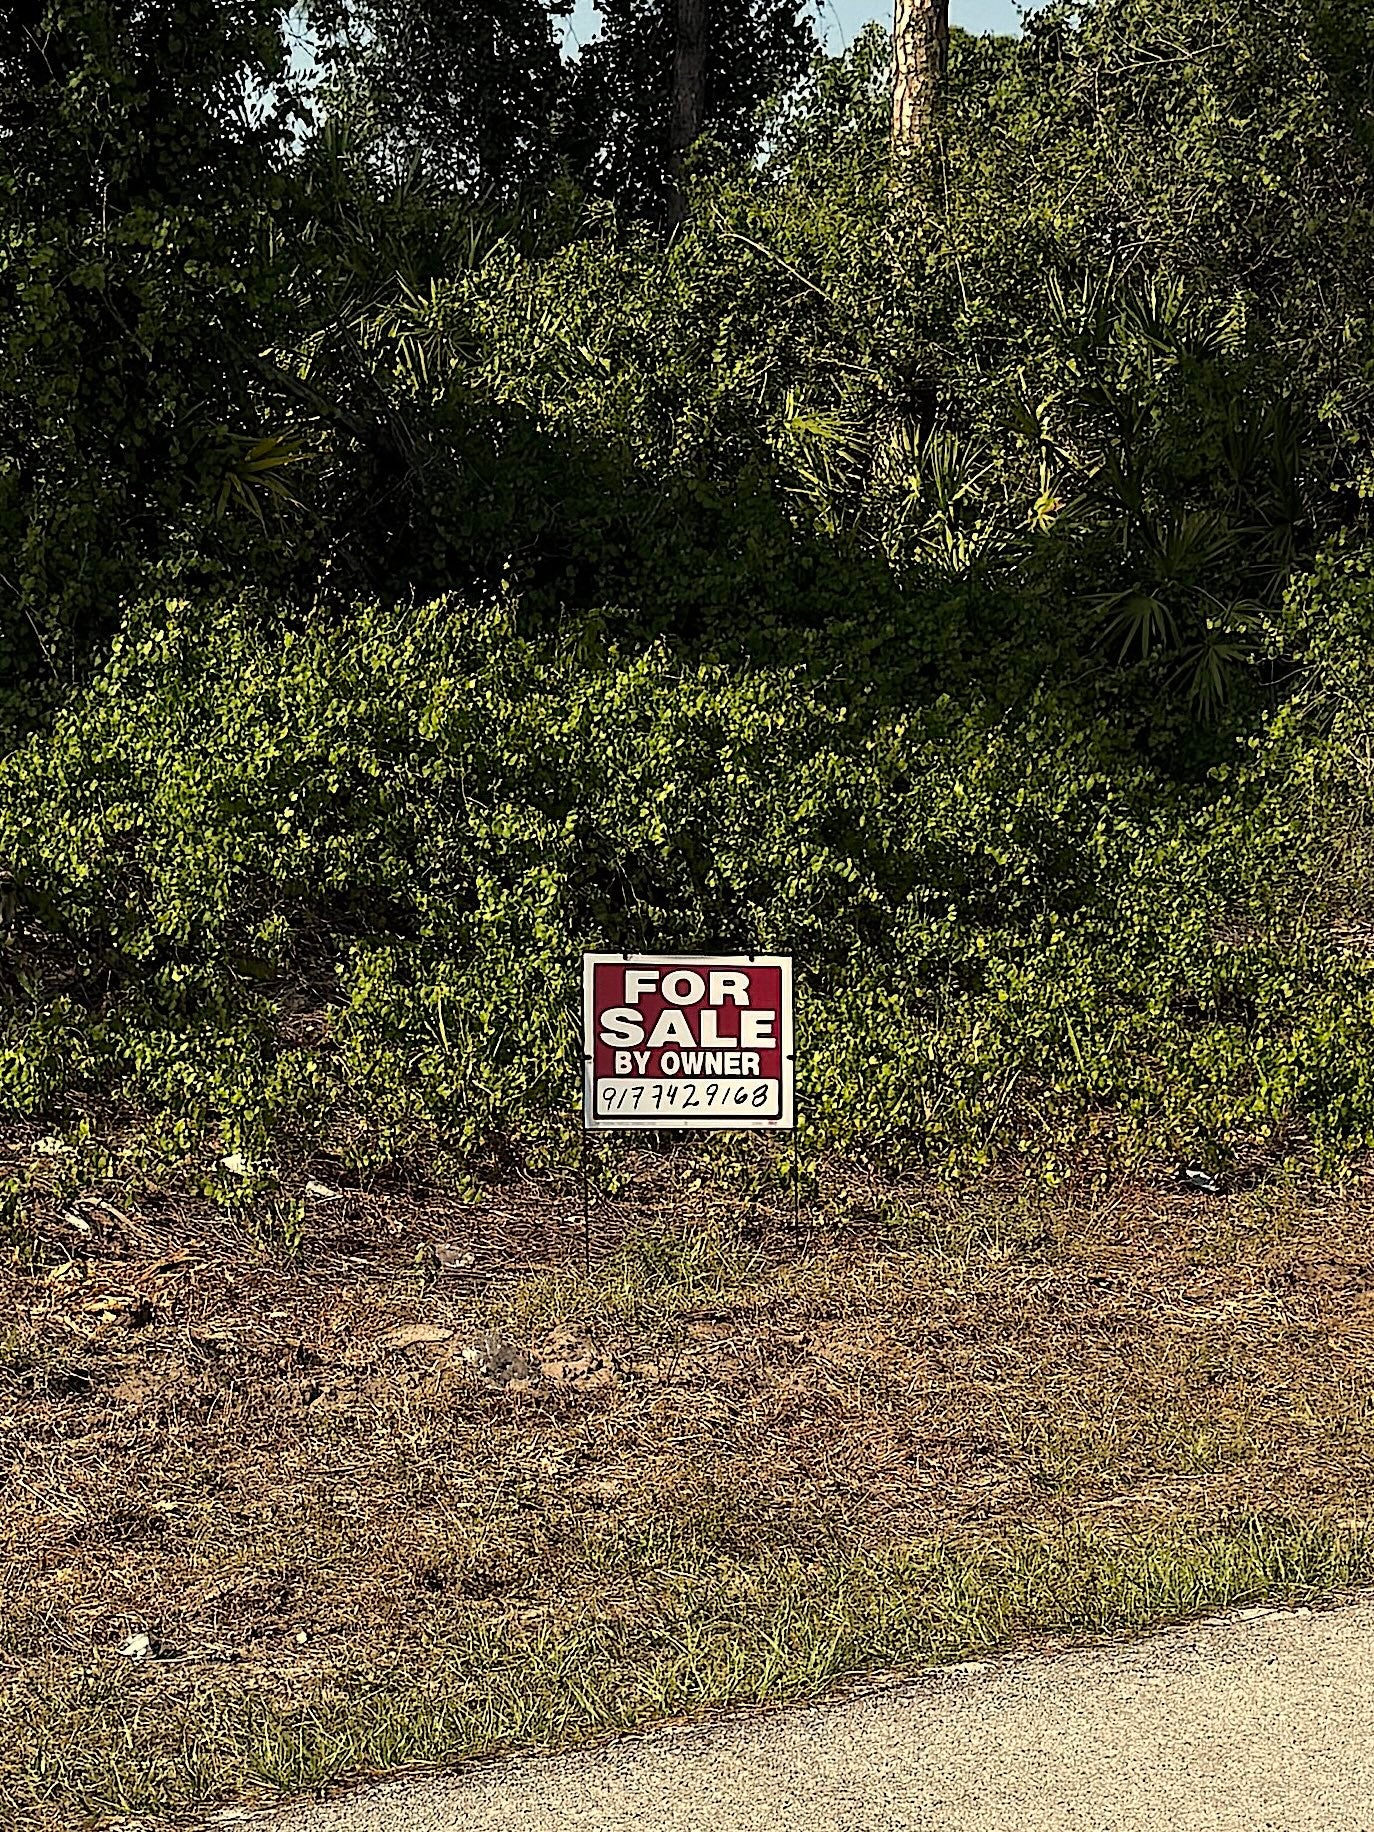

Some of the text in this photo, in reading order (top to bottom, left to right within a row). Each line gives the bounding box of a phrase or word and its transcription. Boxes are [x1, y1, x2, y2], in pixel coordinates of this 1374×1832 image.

[625, 970, 750, 1006] FOR
[600, 1008, 777, 1048] SALE
[615, 1051, 760, 1076] BY OWNER
